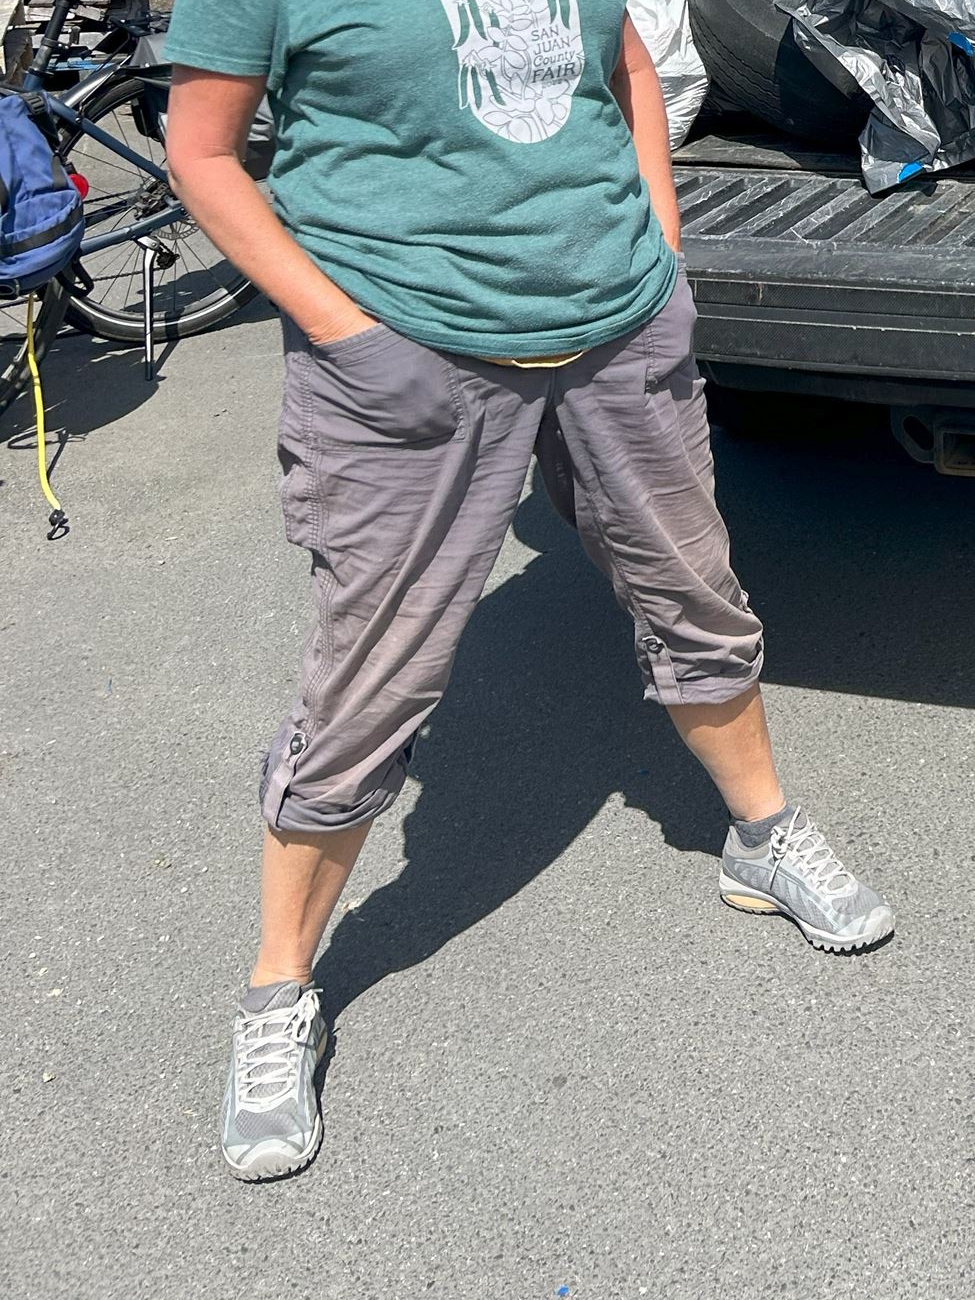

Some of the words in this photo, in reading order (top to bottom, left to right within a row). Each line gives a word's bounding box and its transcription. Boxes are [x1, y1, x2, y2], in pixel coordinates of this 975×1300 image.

[531, 24, 559, 41] SAN
[533, 36, 570, 55] JUAN
[533, 51, 575, 67] County
[531, 62, 576, 83] FAIR
